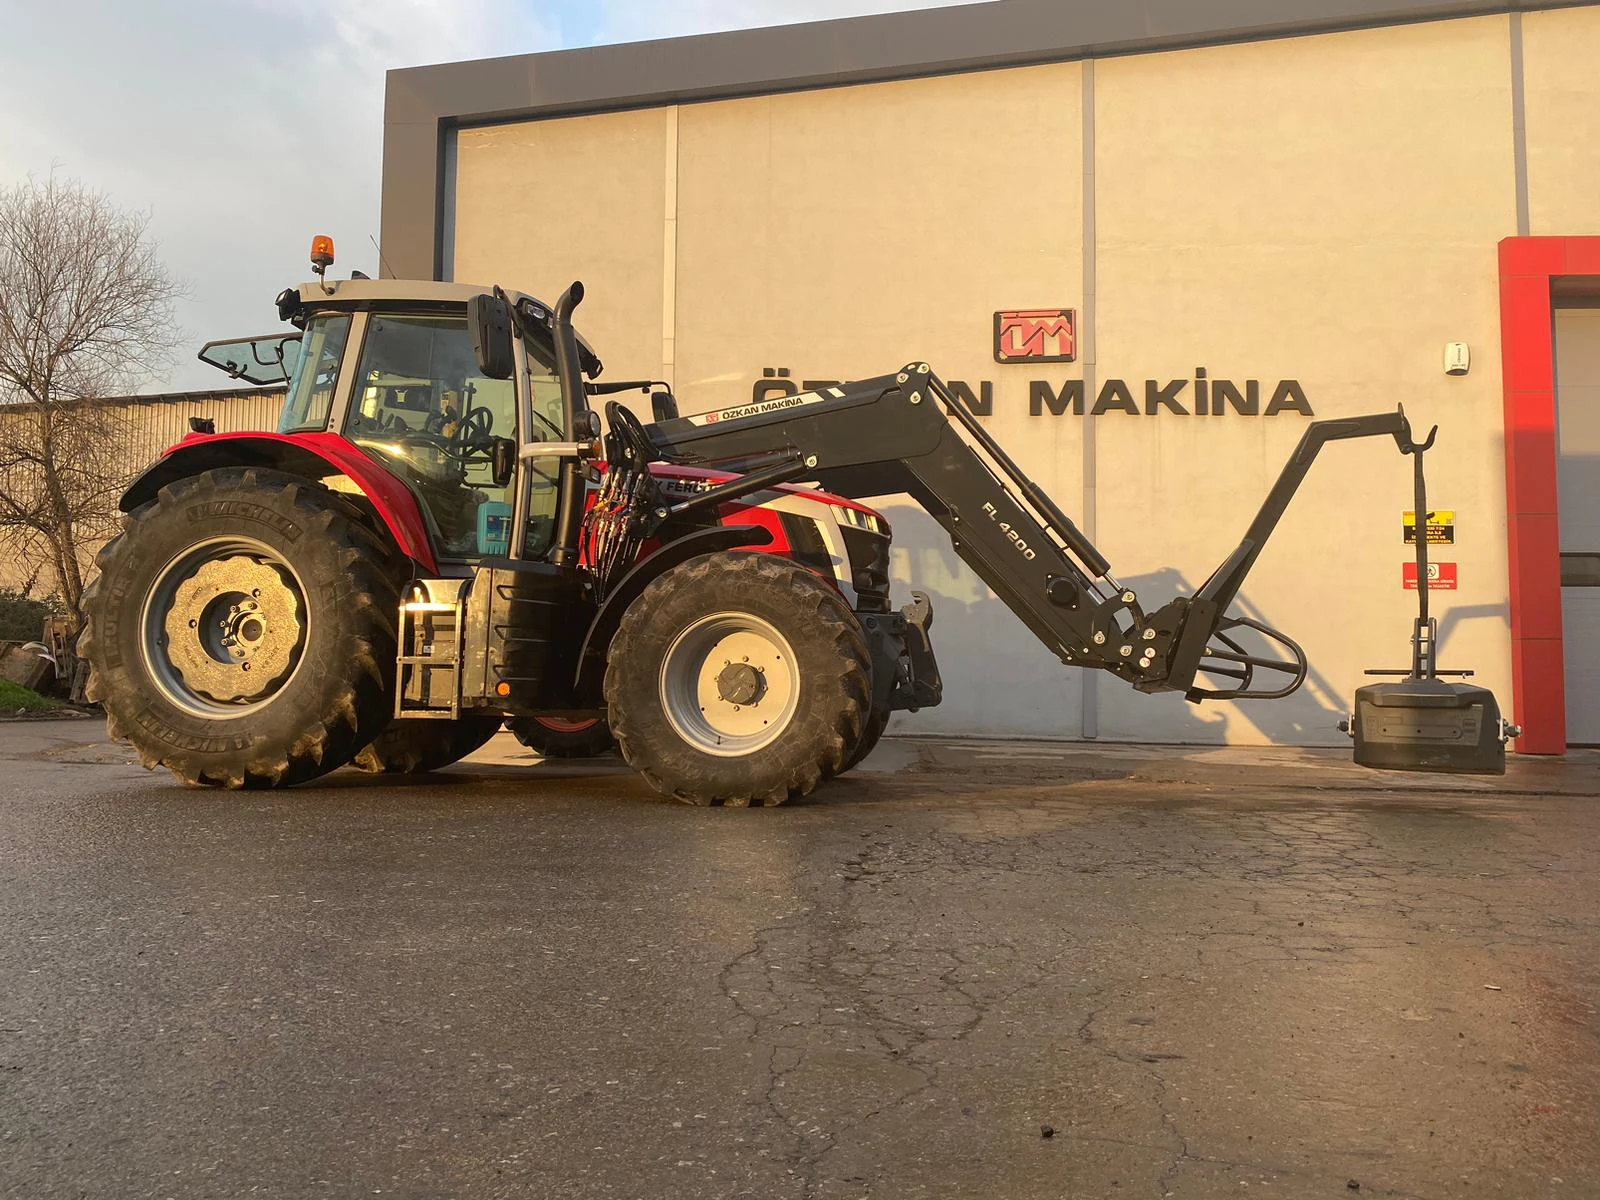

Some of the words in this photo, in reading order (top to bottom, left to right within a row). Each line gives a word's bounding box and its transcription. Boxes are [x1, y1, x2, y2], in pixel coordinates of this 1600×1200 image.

[1029, 366, 1316, 417] MAKİNA
[982, 501, 998, 521] FL
[999, 522, 1037, 561] 4200
